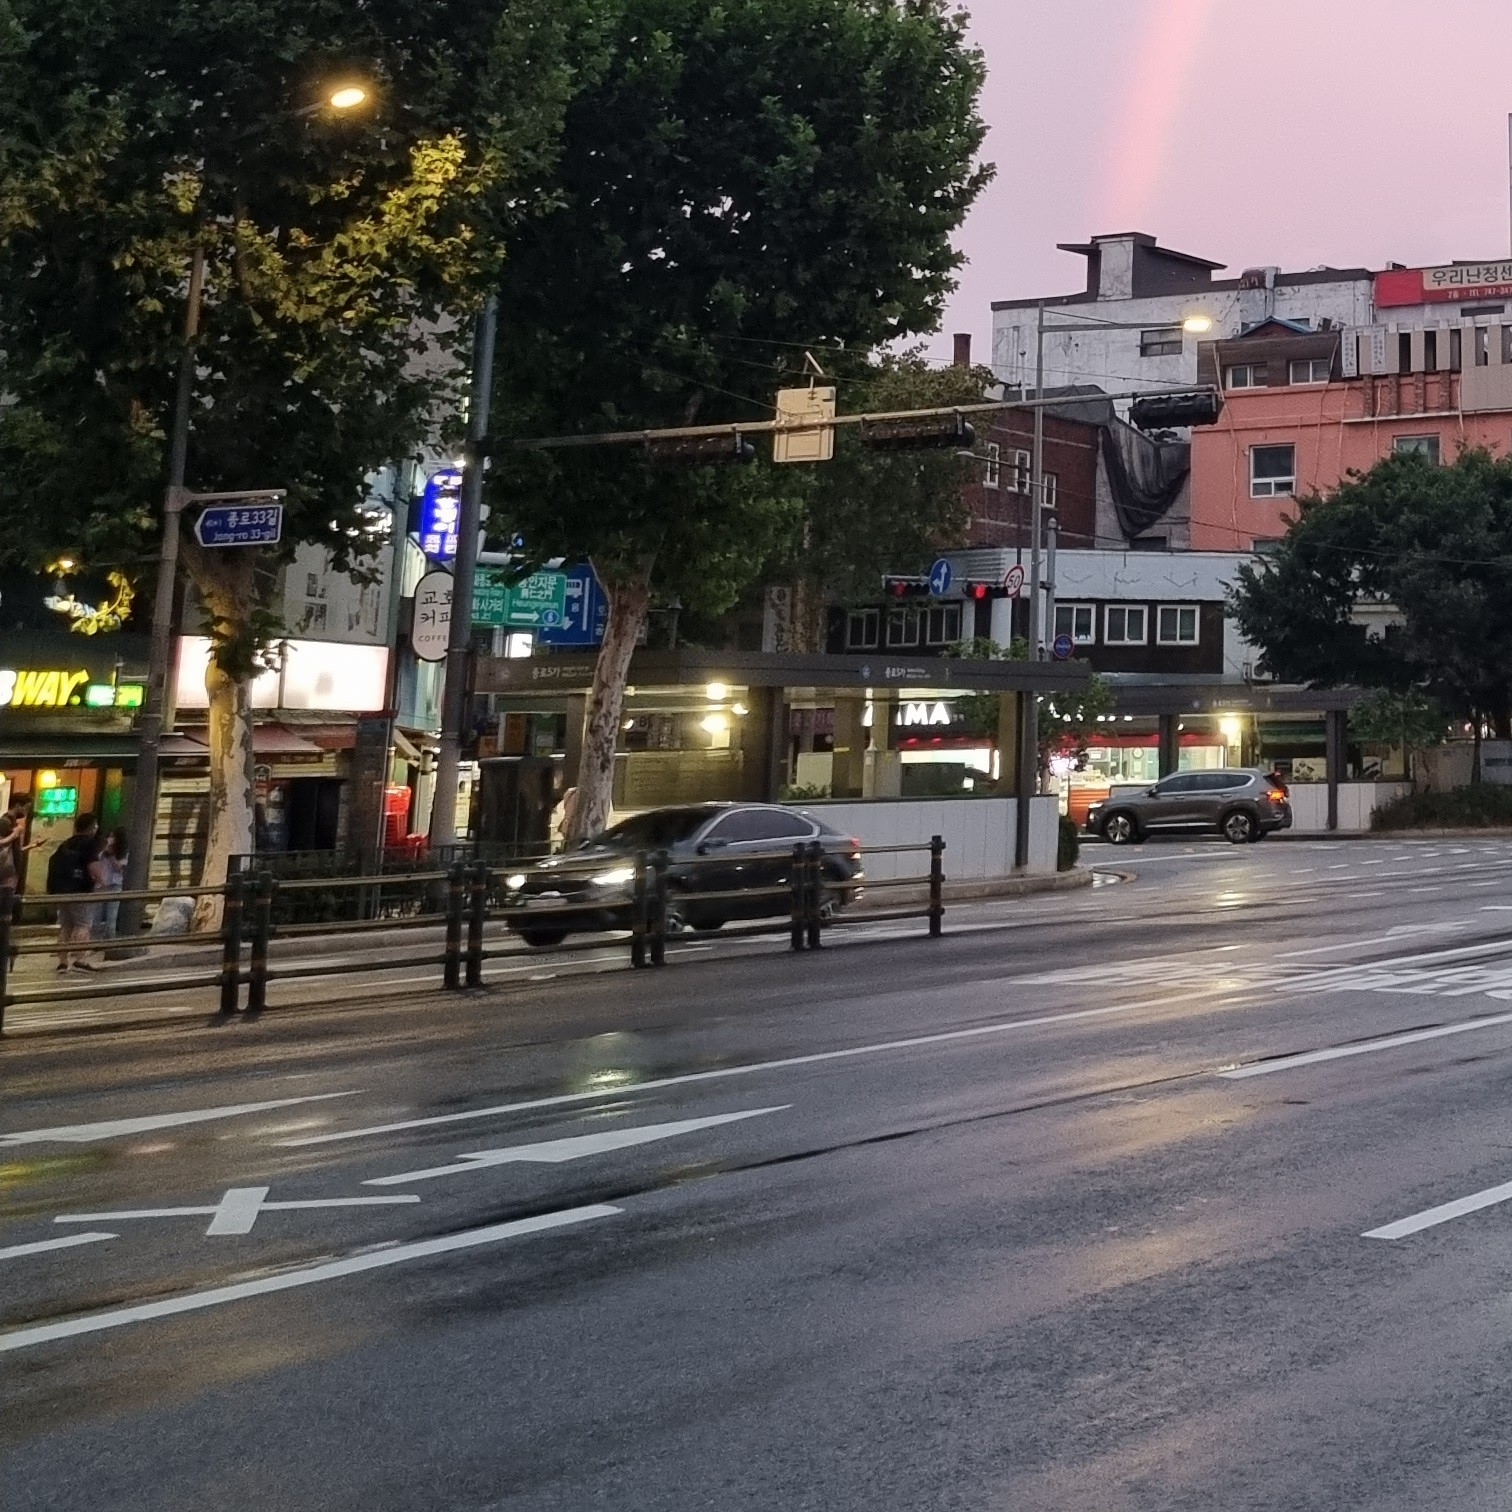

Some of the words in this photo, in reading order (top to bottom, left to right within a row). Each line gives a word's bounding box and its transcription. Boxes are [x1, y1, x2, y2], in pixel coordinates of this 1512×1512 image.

[226, 508, 278, 528] 종로33길
[1007, 574, 1021, 589] 50
[417, 634, 448, 643] COFFE
